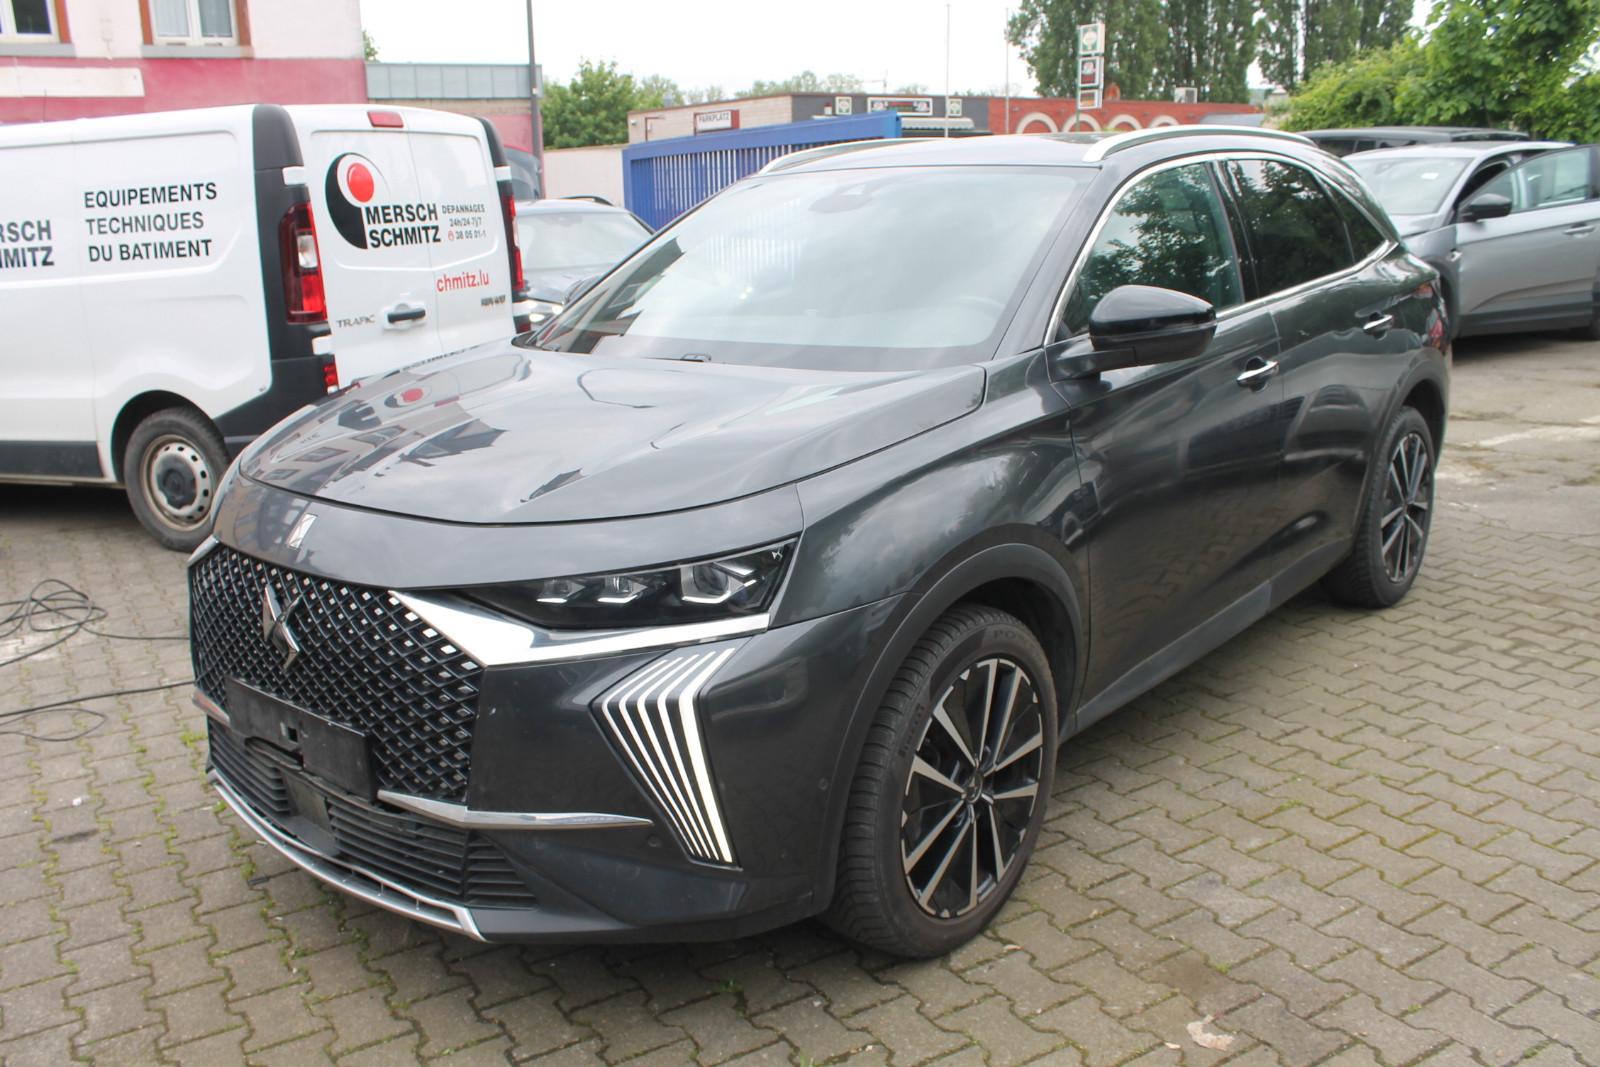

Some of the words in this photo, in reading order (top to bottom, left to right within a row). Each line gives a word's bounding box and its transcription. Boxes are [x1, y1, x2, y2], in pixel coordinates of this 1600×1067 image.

[84, 182, 218, 209] EQUIPEMENTS
[365, 203, 439, 225] MERSCH
[441, 204, 486, 214] DEPANNAGES
[85, 211, 205, 236] TECHNIQUES
[369, 225, 442, 248] SCHMITZ
[0, 246, 55, 269] MITZ
[88, 245, 113, 262] DU
[119, 239, 212, 261] BATIMENT
[436, 270, 490, 292] chmitz.lu
[335, 313, 376, 328] TRAFIC
